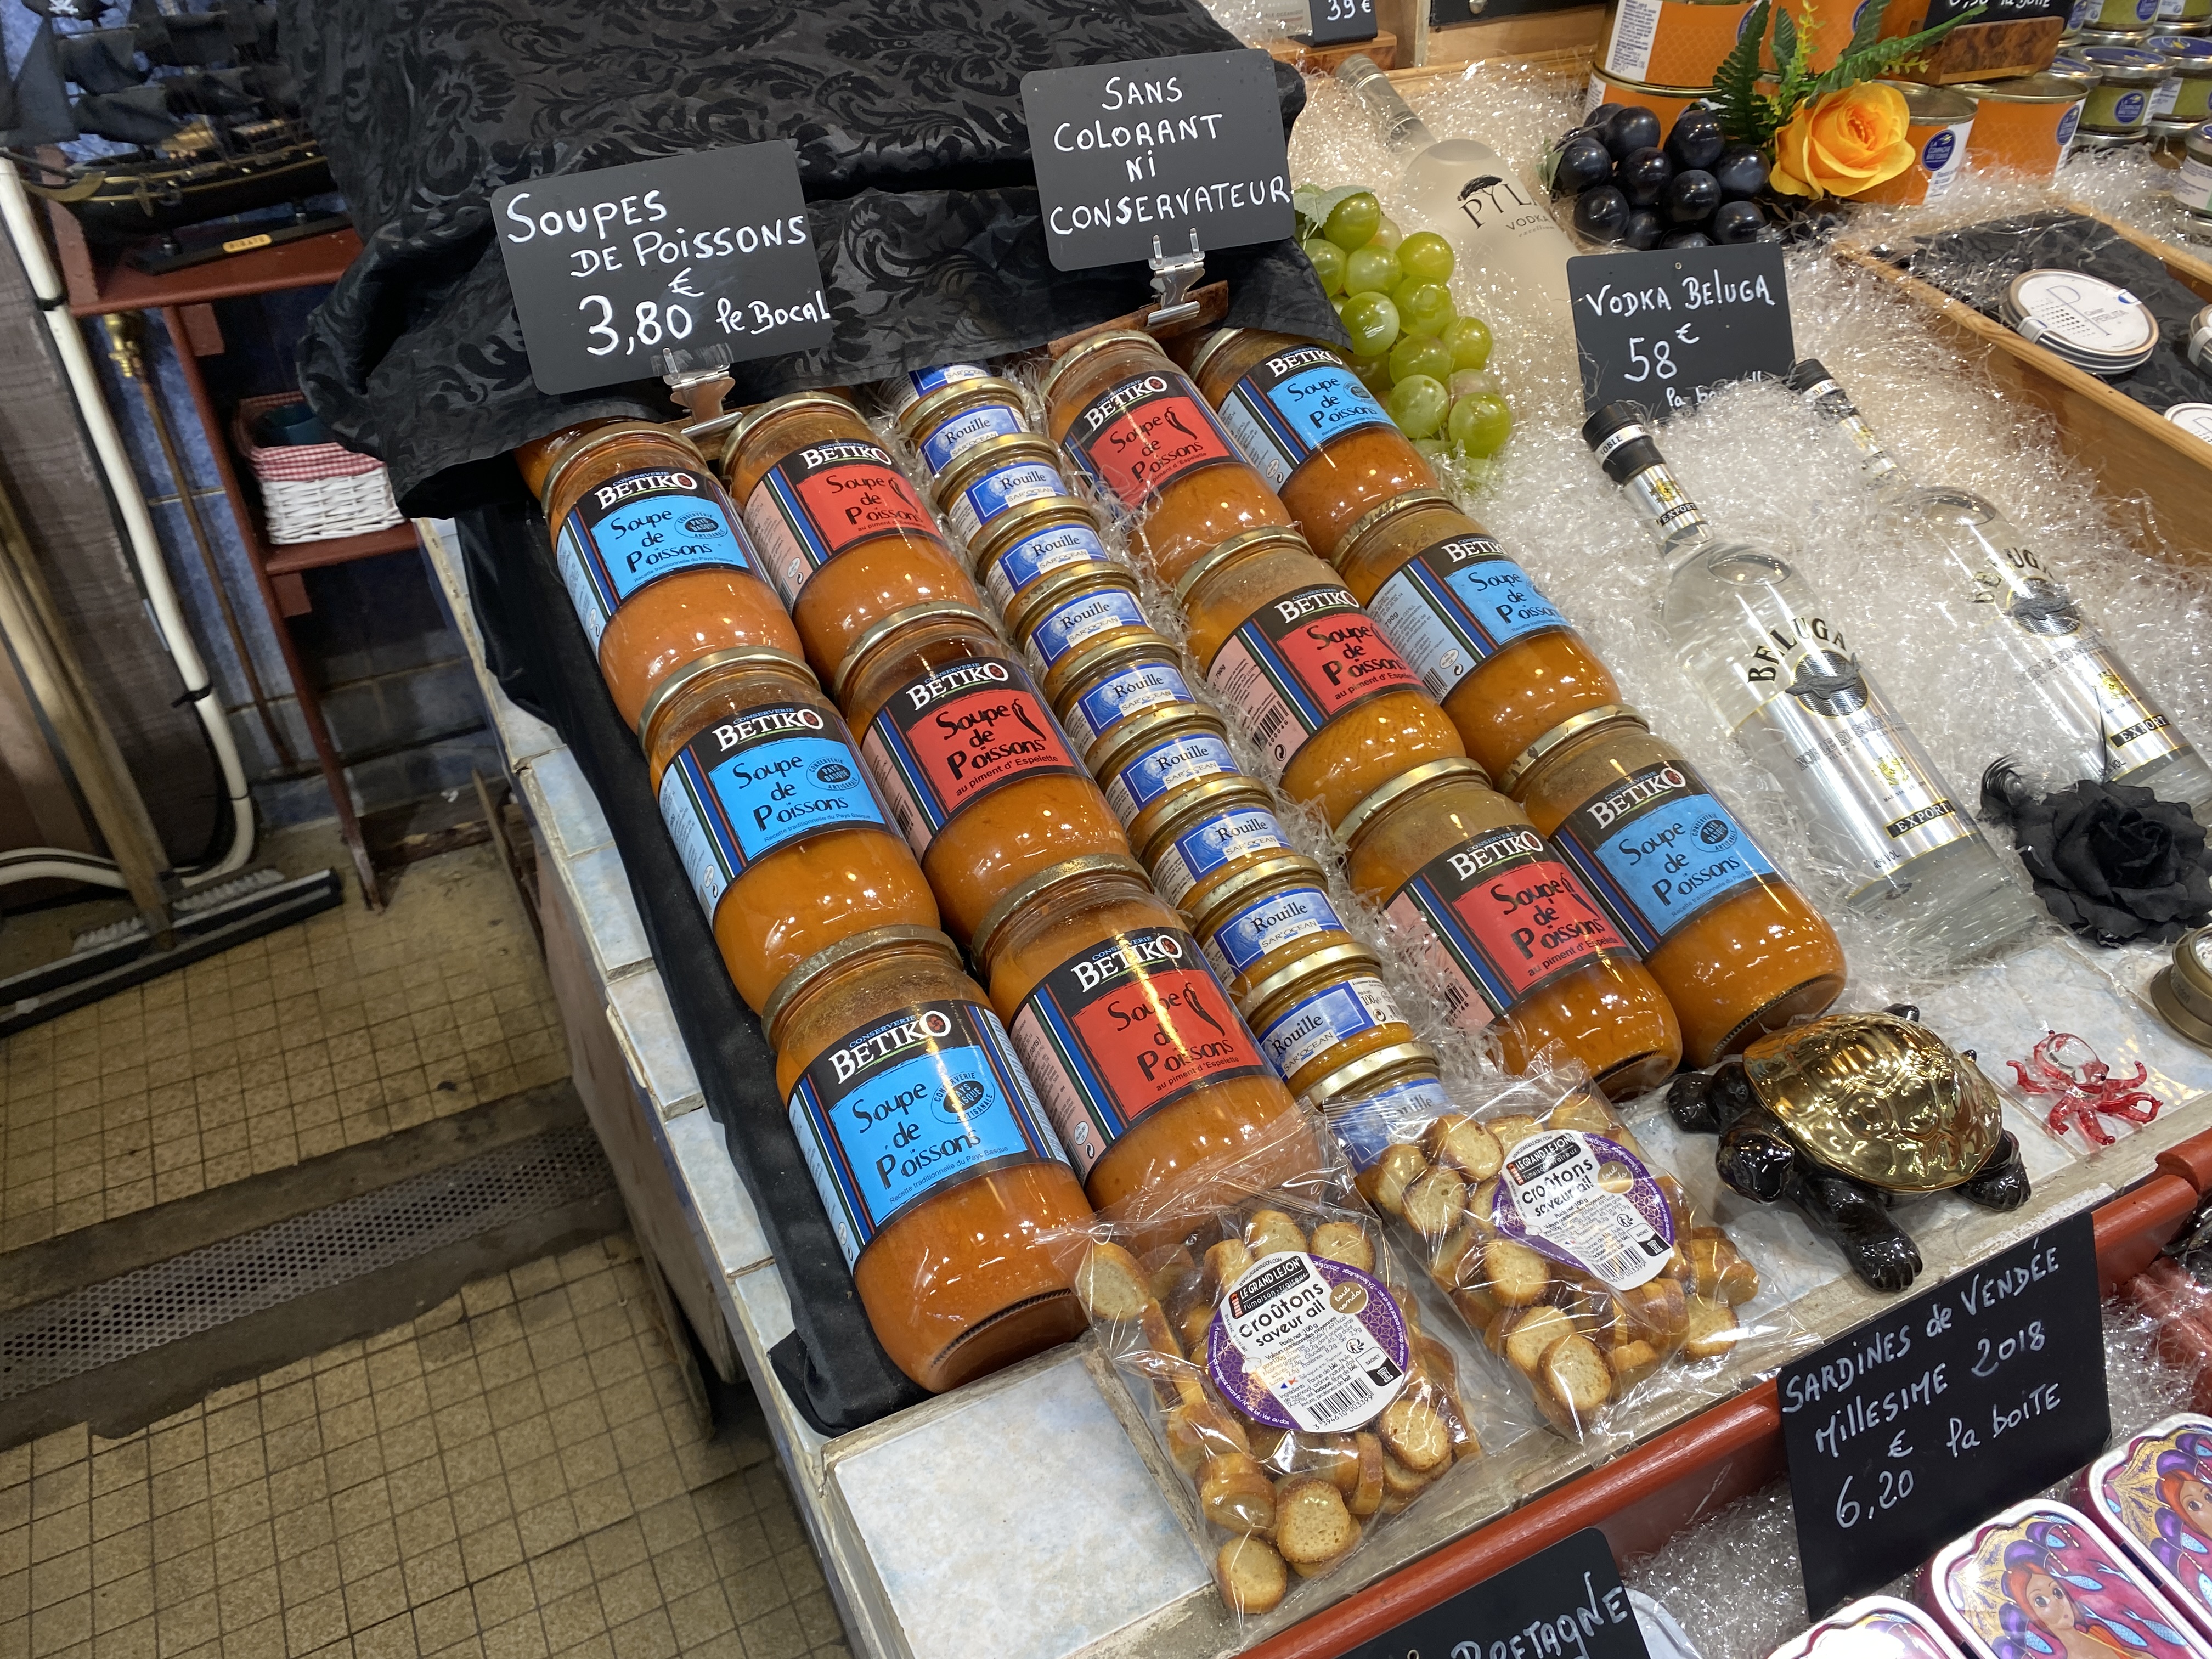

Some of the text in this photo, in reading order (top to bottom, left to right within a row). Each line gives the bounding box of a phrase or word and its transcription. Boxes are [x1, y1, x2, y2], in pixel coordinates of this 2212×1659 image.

[1102, 76, 1183, 110] SANS
[1054, 113, 1223, 152] COLORANT
[507, 190, 667, 242] SOUPES
[1049, 175, 1290, 234] CONSERVATEUR
[1506, 215, 1551, 230] VODKA
[570, 246, 622, 277] DE
[668, 267, 704, 297] €
[1585, 284, 1671, 317] VODKA
[579, 295, 693, 356] 3,80
[715, 297, 745, 334] le
[1675, 323, 1700, 344] €
[1266, 350, 1344, 377] BETIKO
[1624, 337, 1678, 382] 58
[1084, 376, 1168, 432] BETIKO
[1287, 377, 1341, 402] Soupe
[1321, 394, 1340, 409] de
[944, 417, 991, 445] Rouille
[1309, 405, 1378, 429] Poissons
[1109, 414, 1164, 454] Soupe
[799, 445, 893, 470] BETIKO
[1131, 441, 1204, 483] Poissons
[594, 472, 698, 510] BETIKO
[612, 471, 670, 488] CONSERVERIE
[826, 475, 886, 494] Soupe
[999, 470, 1047, 490] Rouille
[860, 492, 882, 506] de
[610, 510, 674, 540] Soupe
[844, 506, 921, 525] Poissons
[641, 531, 664, 548] de
[1031, 534, 1081, 557] Rouille
[1441, 538, 1508, 563] BETIK
[625, 543, 713, 574] Poissons
[1468, 572, 1523, 592] Soupe
[1506, 589, 1527, 605] de
[1060, 602, 1110, 630] Rouille
[1274, 588, 1360, 624] BETIKO
[1306, 624, 1373, 651] Soupe
[1342, 642, 1367, 659] de
[905, 662, 1009, 711] BETIKO
[1112, 673, 1164, 699] Rouille
[1322, 658, 1404, 686] Poissons
[712, 708, 824, 752] BETIKO
[733, 707, 795, 724] CONSERVERIE
[935, 704, 1011, 740] Soupe
[969, 727, 996, 748] de
[732, 755, 804, 790] Soupe
[946, 738, 1046, 780] Poissons
[1155, 744, 1210, 771] Rouille
[956, 785, 968, 797] au
[968, 766, 1004, 788] piment
[1015, 754, 1059, 766] Espelette
[1604, 770, 1657, 801] CONSERVERIE
[770, 782, 797, 801] de
[1585, 766, 1687, 830] BETIKO
[752, 795, 849, 832] Poissons
[1895, 802, 1951, 833] EXPORT
[1215, 818, 1268, 842] Rouille
[1466, 831, 1518, 853] CONSERVERIE
[1618, 821, 1686, 866] Soupe
[1446, 830, 1544, 881] BETIKO
[1663, 851, 1690, 874] de
[1489, 876, 1564, 915] Soupe
[1651, 855, 1741, 907] Poissons
[1250, 901, 1308, 934] Rouille
[1532, 904, 1561, 927] de
[1261, 919, 1317, 948] SAR'OCEAN
[1510, 918, 1606, 960] Poissons
[1070, 934, 1183, 994] BETIKO
[849, 1014, 918, 1048] CONSERVERIE
[1271, 1013, 1324, 1057] Rouille
[828, 1010, 952, 1085] BETIKO
[1283, 1031, 1334, 1073] SAR'OCEAN
[851, 1082, 929, 1134] Soupe
[891, 1120, 922, 1149] de
[874, 1129, 981, 1190] Poissons
[889, 1144, 1009, 1205] Recette traditionnelle du Pays Basque
[1239, 1260, 1301, 1300] LE GRAND LEJON
[1334, 1285, 1351, 1302] tout
[1926, 1304, 1953, 1338] de
[1960, 1237, 2059, 1316] VENDÉE
[1255, 1299, 1326, 1347] saveur ail
[1279, 1338, 1294, 1347] Poids
[1971, 1321, 2045, 1377] 2018
[1365, 1353, 1381, 1366] SACHET
[1322, 1411, 1347, 1426] 394610
[1348, 1394, 1373, 1412] 003399
[1887, 1429, 1914, 1458] €
[1946, 1417, 1981, 1458] la
[1836, 1470, 1914, 1528] 6,20
